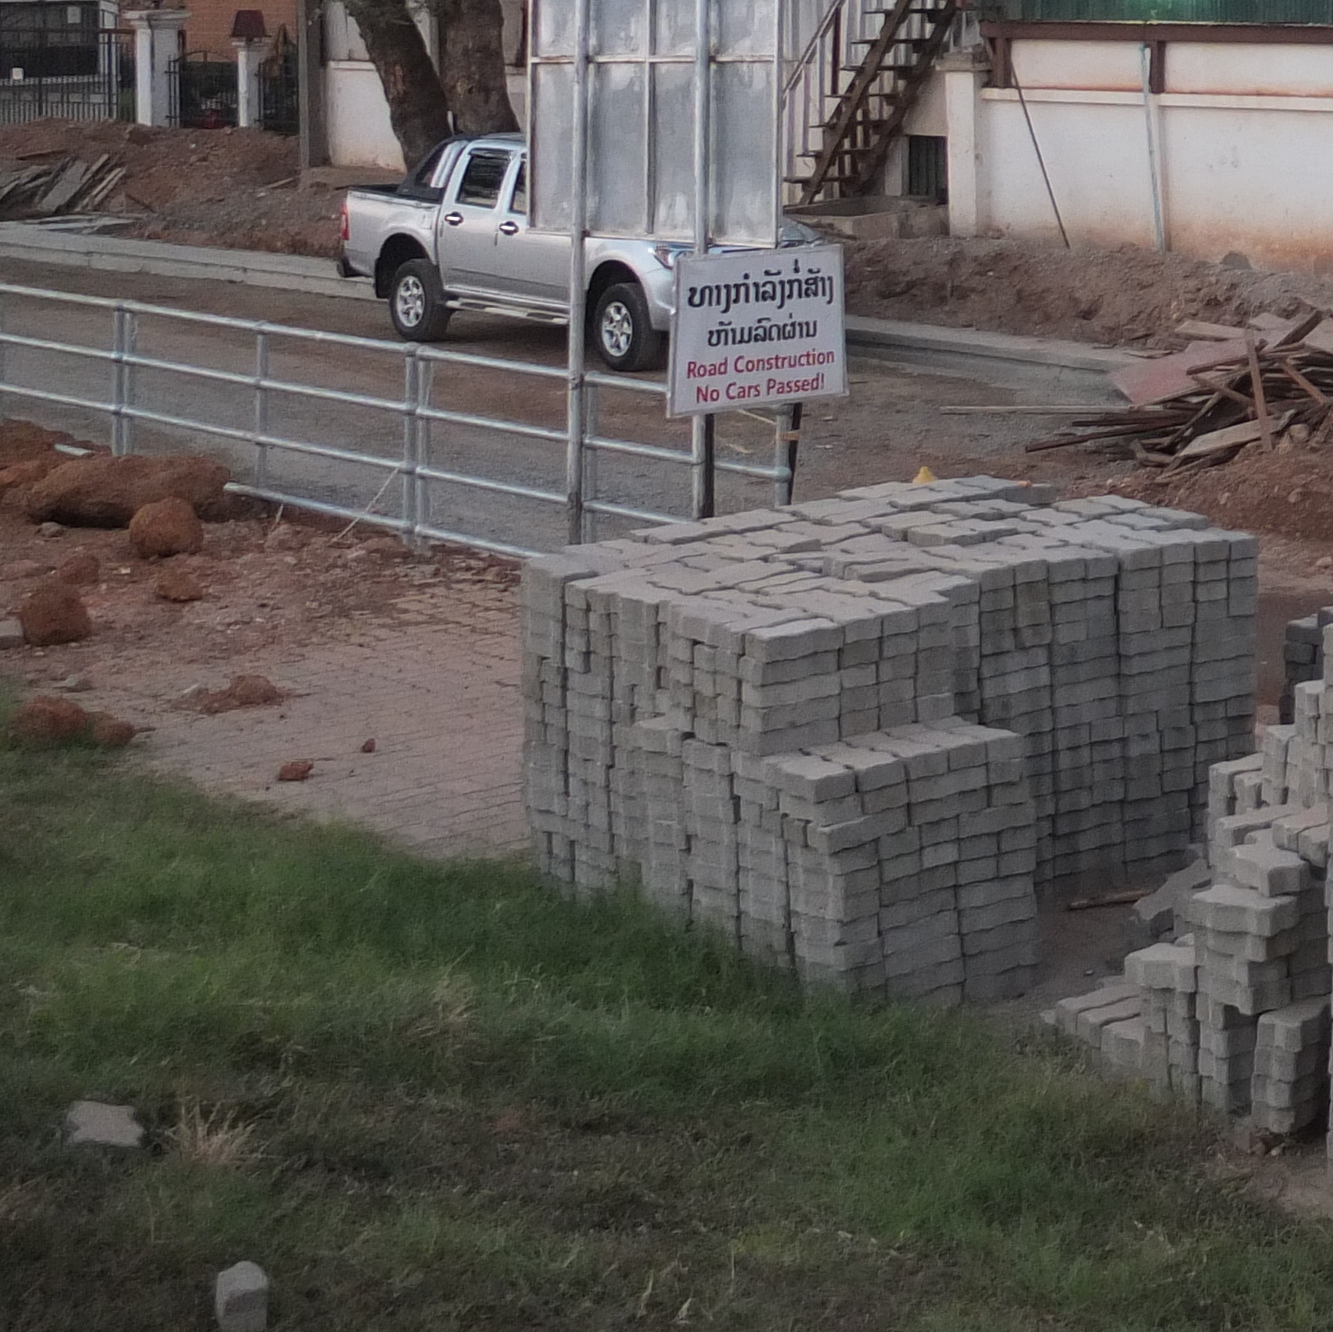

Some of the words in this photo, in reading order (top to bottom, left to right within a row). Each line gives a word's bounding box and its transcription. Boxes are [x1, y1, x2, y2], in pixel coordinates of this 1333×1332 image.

[707, 313, 817, 347] ຫ້າມລົດຜ່ານ
[687, 357, 728, 379] Road
[734, 348, 835, 373] Construction
[696, 384, 720, 404] No
[725, 382, 761, 400] Cars
[766, 373, 825, 396] Passed!
